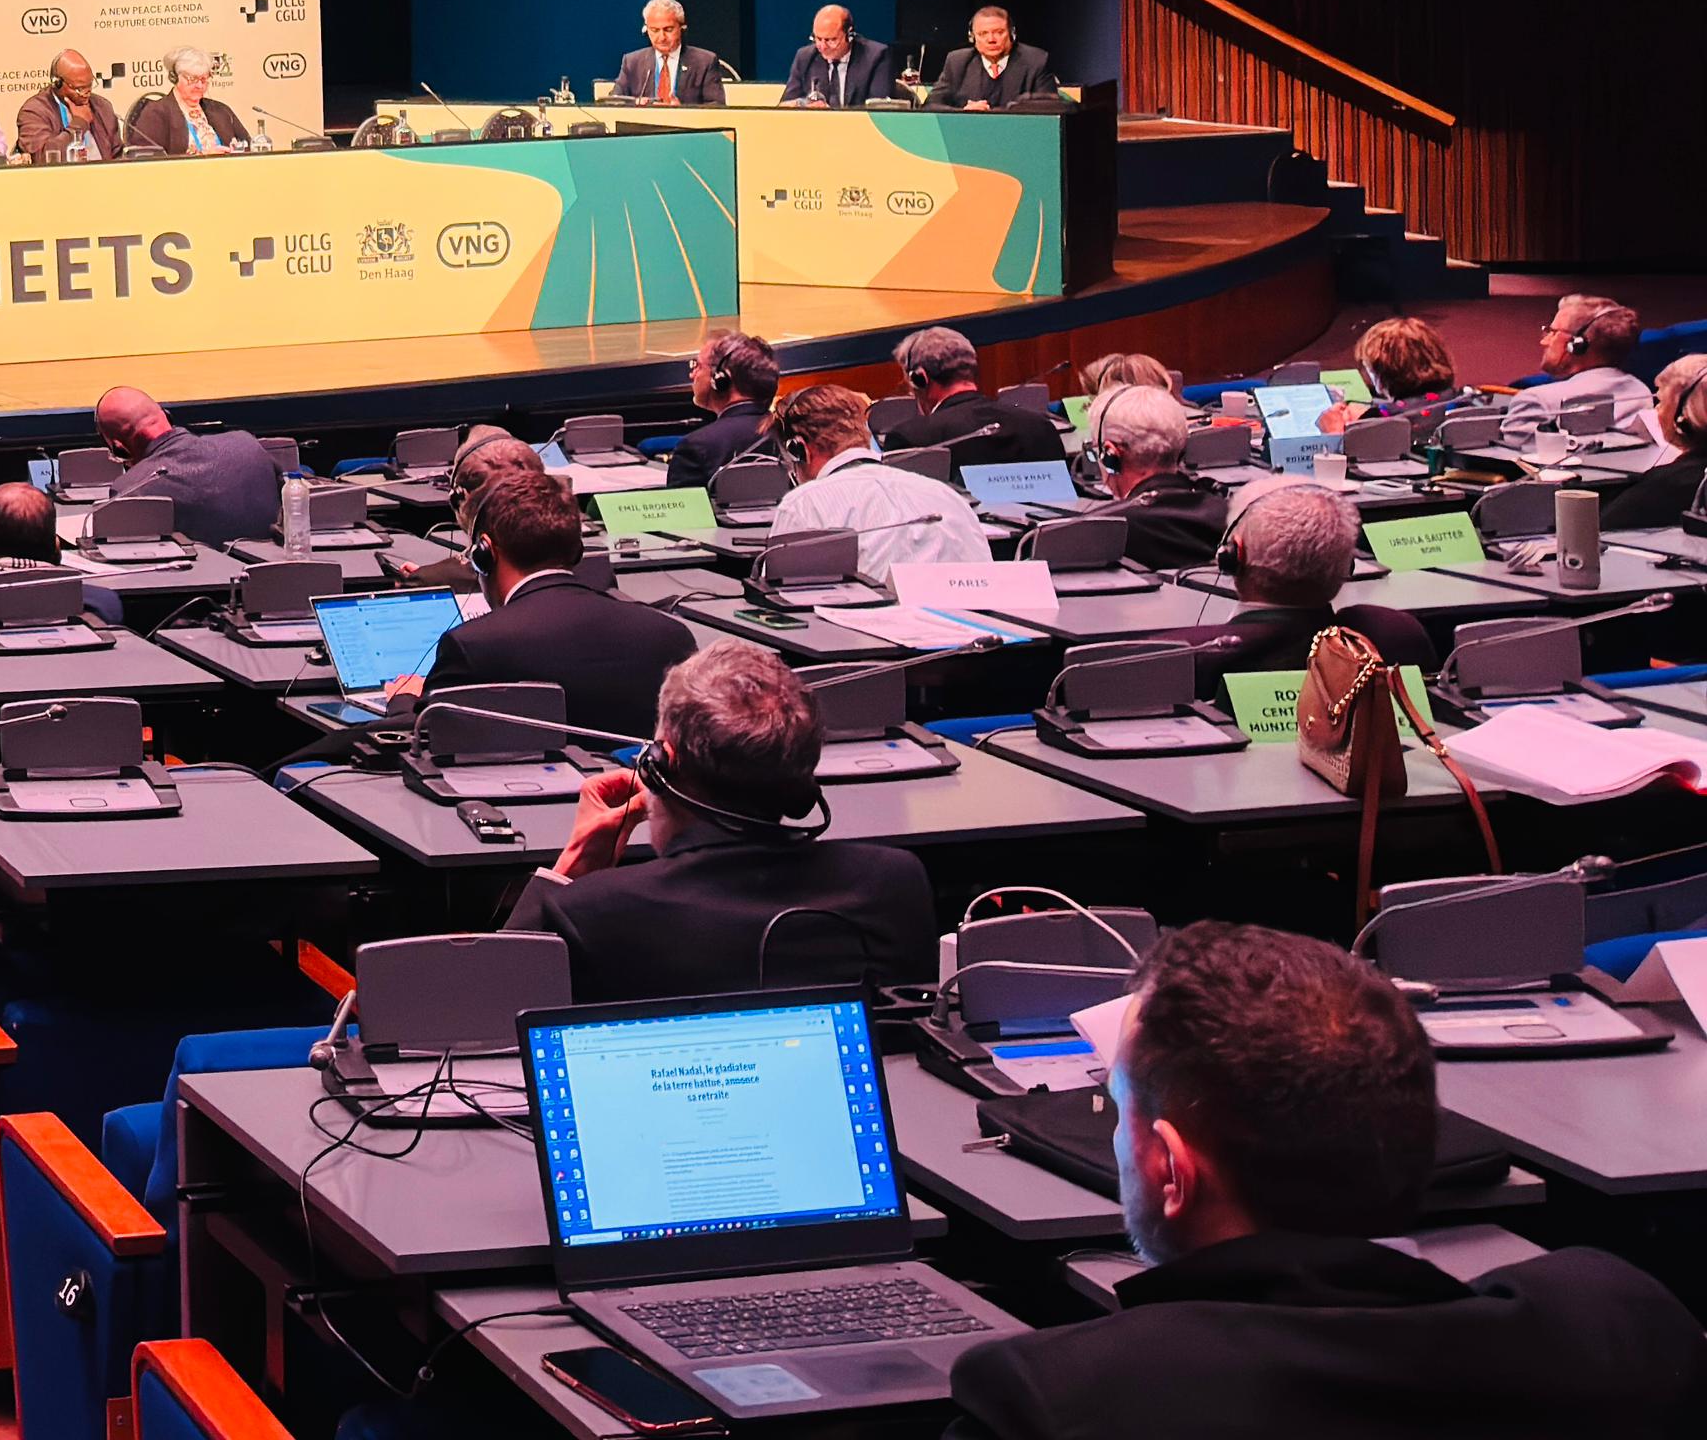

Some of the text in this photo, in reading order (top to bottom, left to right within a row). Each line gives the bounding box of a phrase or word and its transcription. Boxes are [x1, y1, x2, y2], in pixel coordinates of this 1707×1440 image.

[275, 9, 306, 22] CGLU
[270, 60, 301, 72] VNG
[793, 189, 822, 200] UCLG
[794, 200, 823, 211] CGLU
[894, 197, 928, 210] VNG
[285, 233, 332, 254] UCLG
[448, 234, 500, 257] VNG
[286, 254, 332, 275] CGLU
[359, 266, 414, 282] Den Haag
[949, 579, 989, 588] PARIS
[650, 1068, 678, 1079] Rafael
[714, 1063, 756, 1075] gladiateur
[672, 1081, 693, 1090] terre
[698, 1090, 729, 1102] retraite
[60, 1279, 79, 1307] 16
